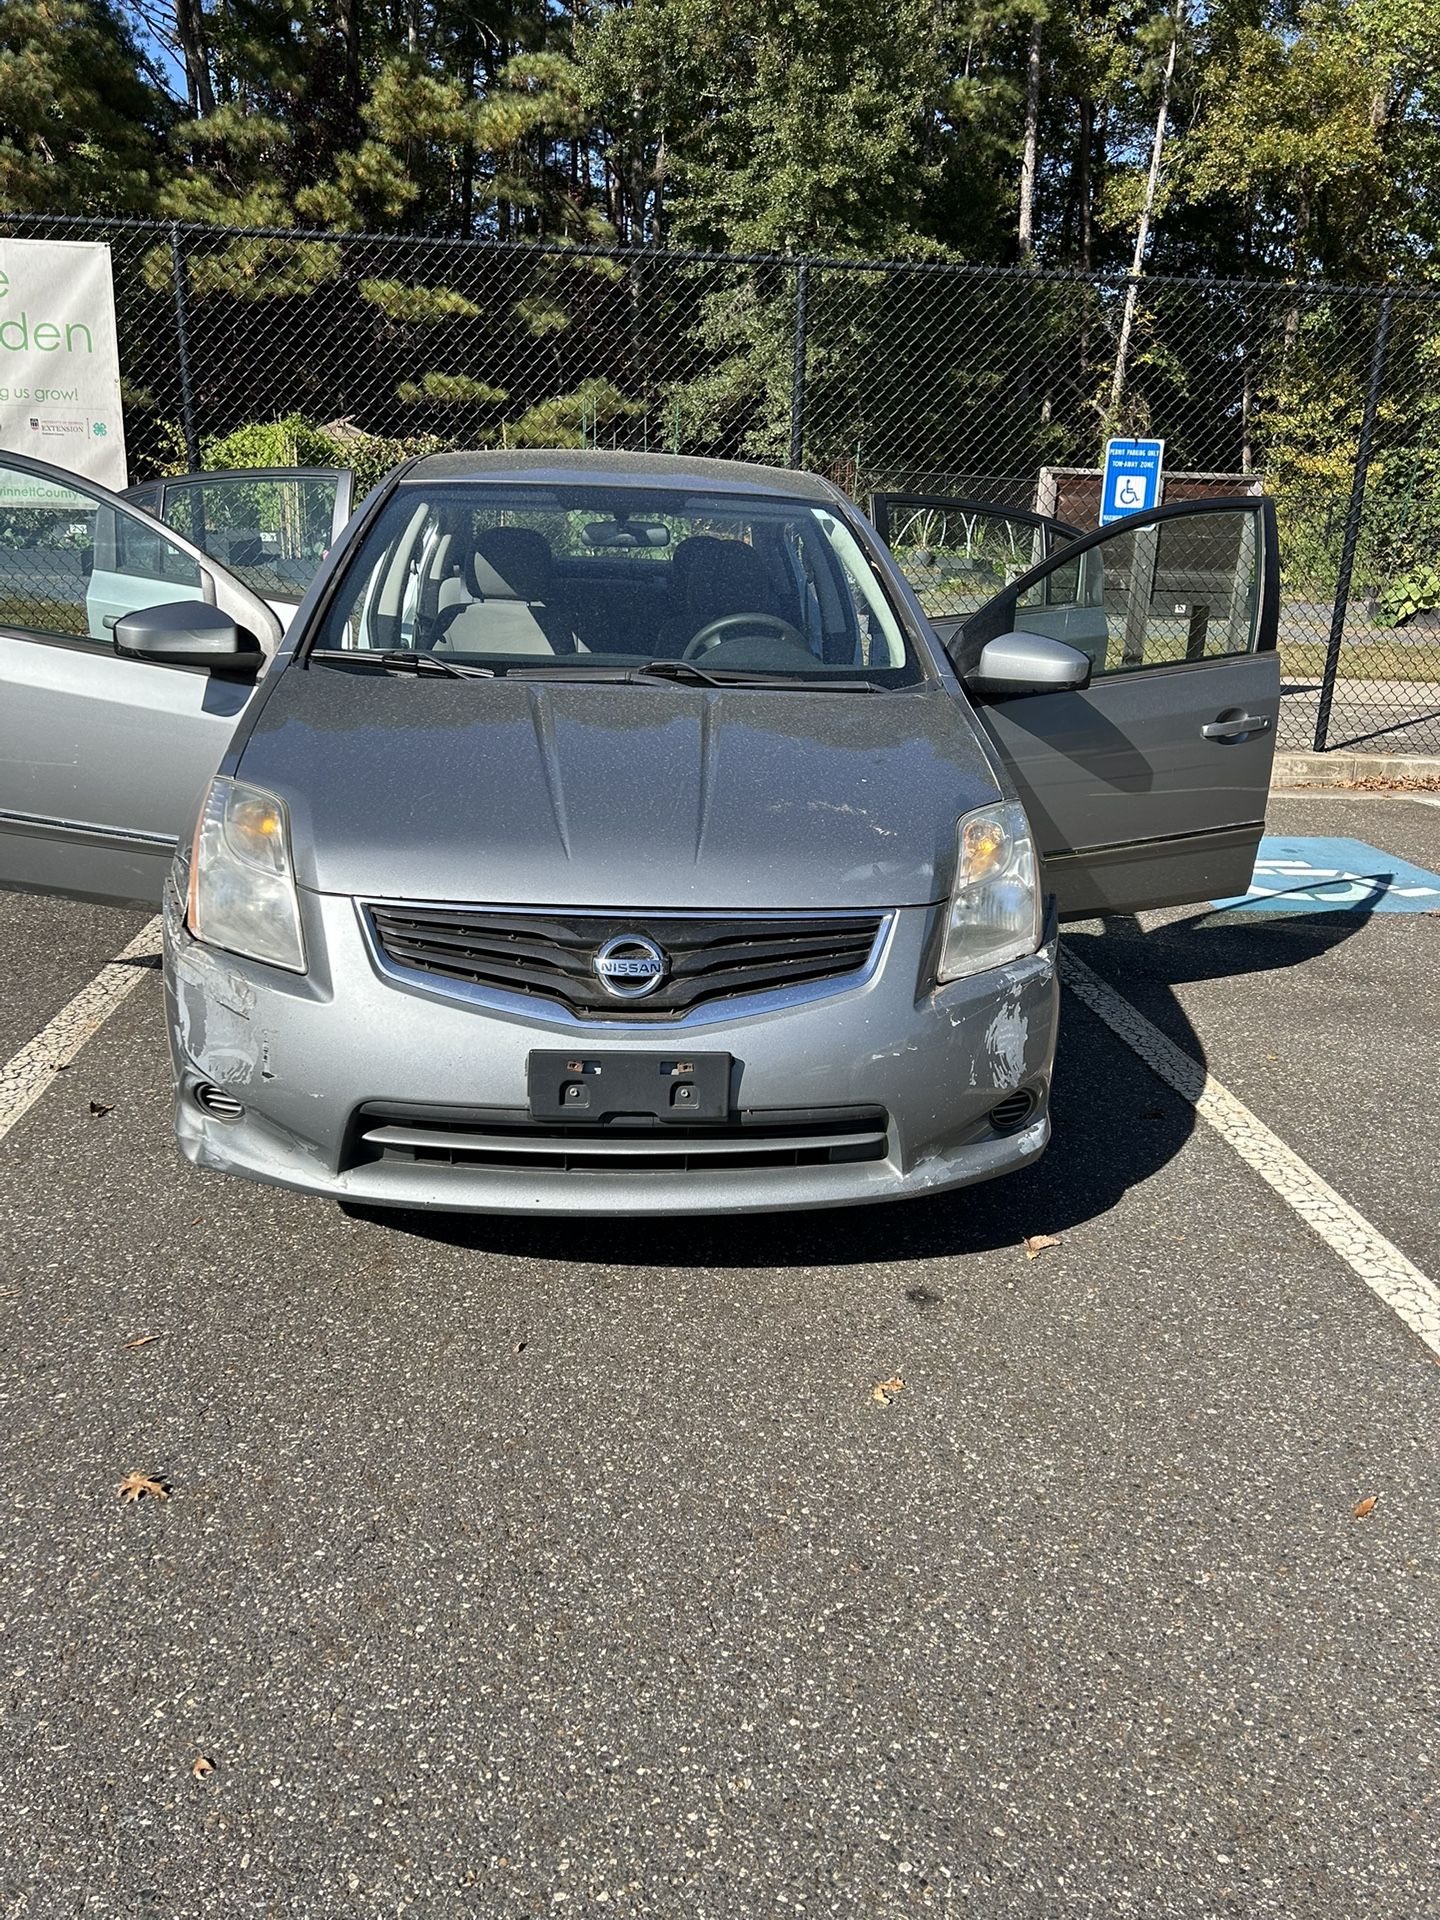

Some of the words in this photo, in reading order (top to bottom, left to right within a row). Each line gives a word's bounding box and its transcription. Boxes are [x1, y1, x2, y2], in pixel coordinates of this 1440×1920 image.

[14, 388, 30, 399] us
[34, 387, 79, 403] grow!
[41, 425, 84, 433] EXTENSION
[1140, 461, 1154, 469] ZONE
[601, 963, 661, 973] NISSAN
